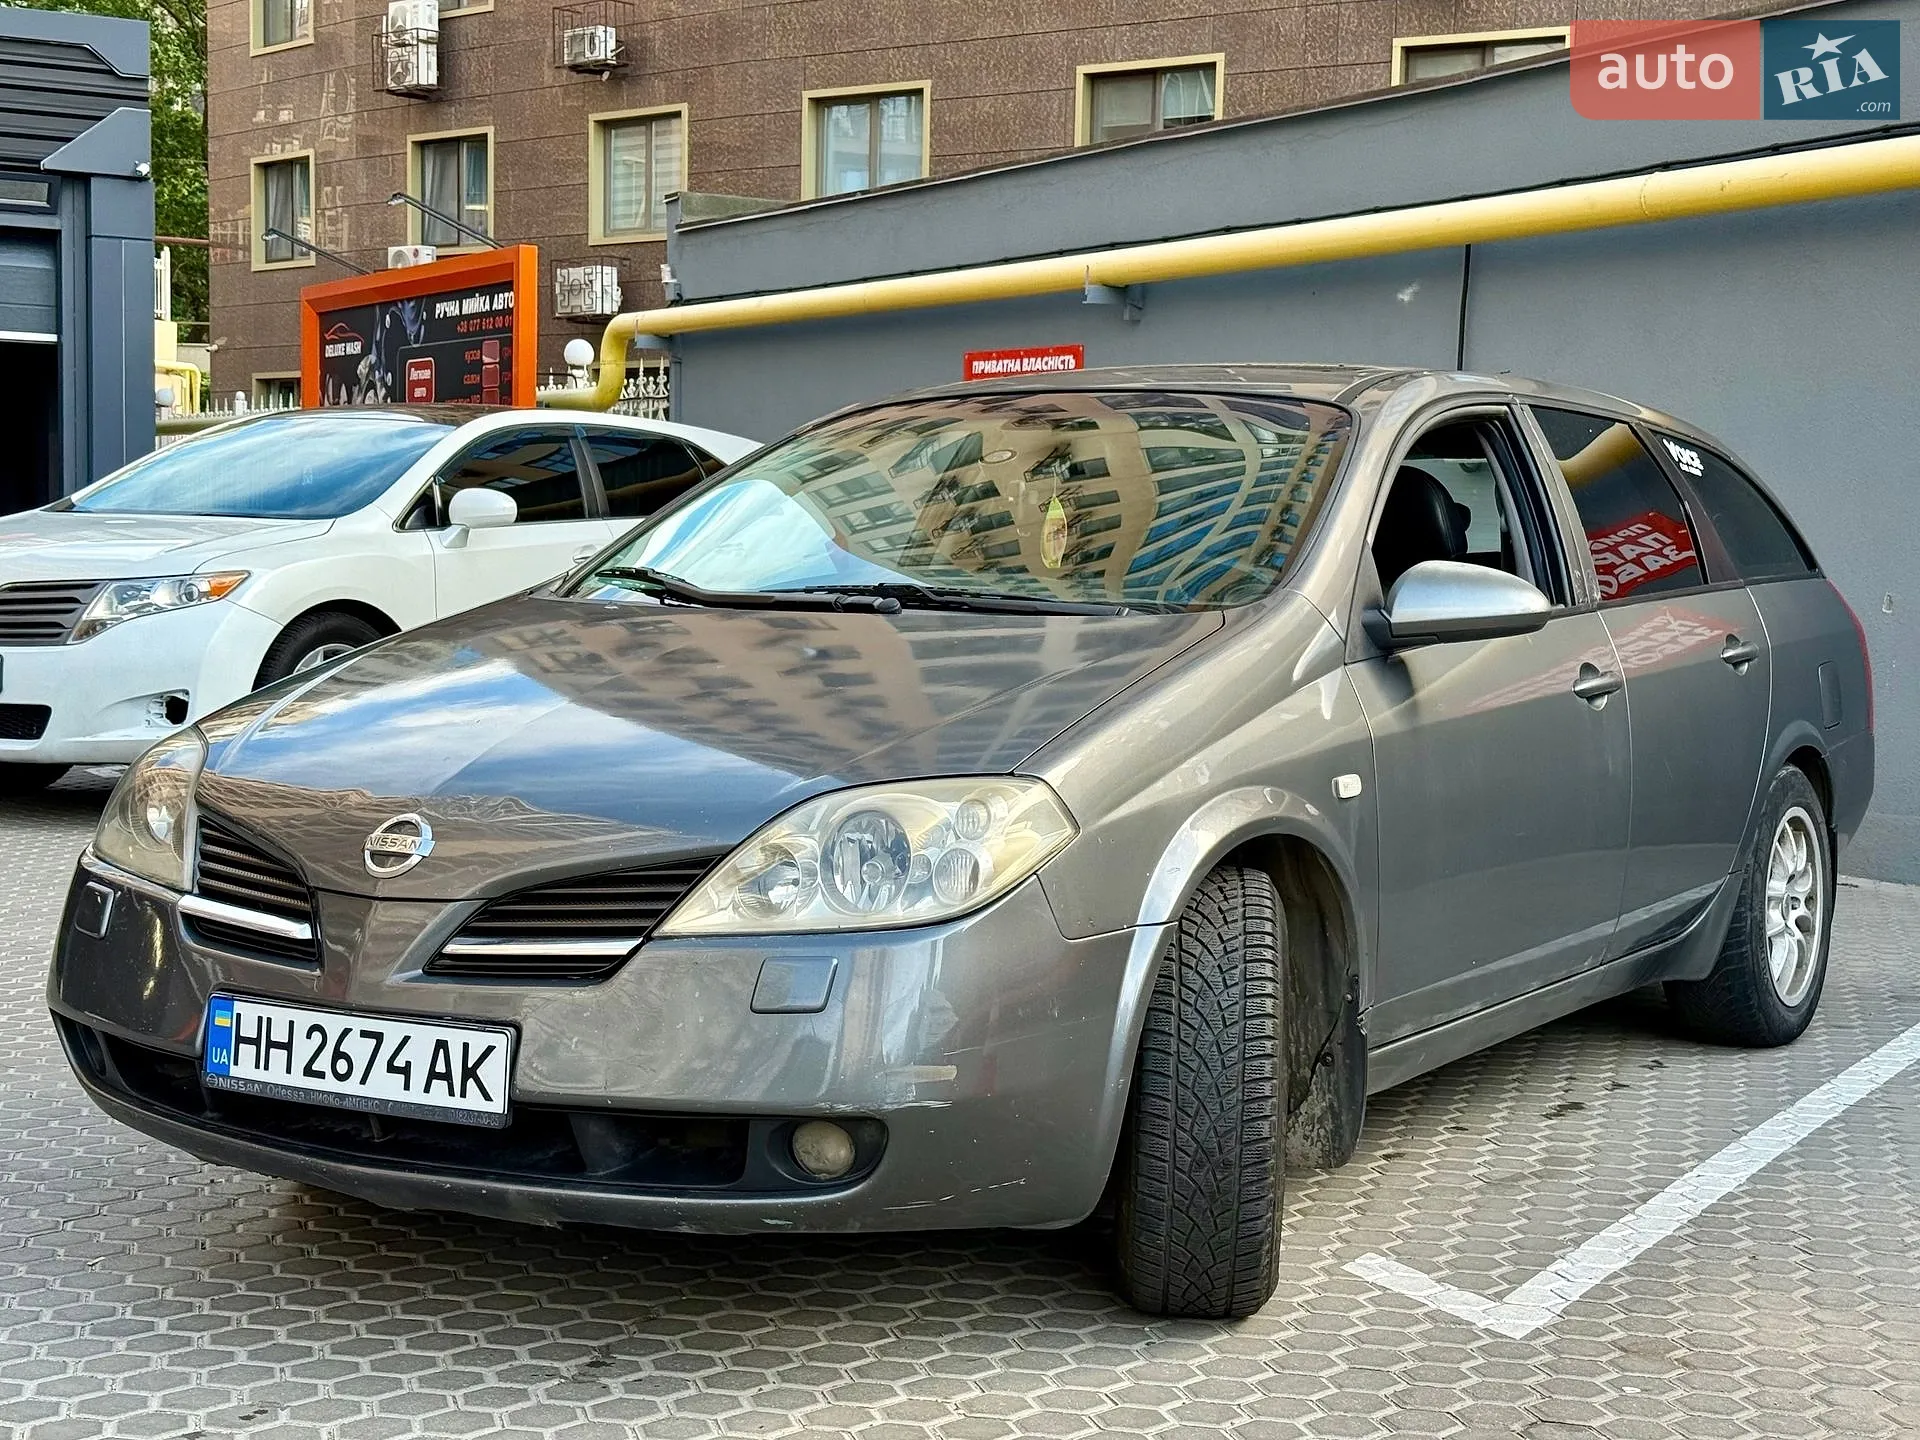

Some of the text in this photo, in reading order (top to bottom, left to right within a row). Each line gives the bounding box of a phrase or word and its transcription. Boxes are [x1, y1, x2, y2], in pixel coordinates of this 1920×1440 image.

[435, 291, 514, 319] РУЧНА МИЙКА АВТО
[325, 341, 361, 358] DELUXE WASH
[972, 354, 1076, 374] ПРИВАТНА ВЛАСНІСТЬ
[366, 836, 423, 851] NISSAN
[212, 1047, 229, 1065] UA
[218, 1077, 262, 1093] NISSAN
[267, 1083, 305, 1101] Odessa
